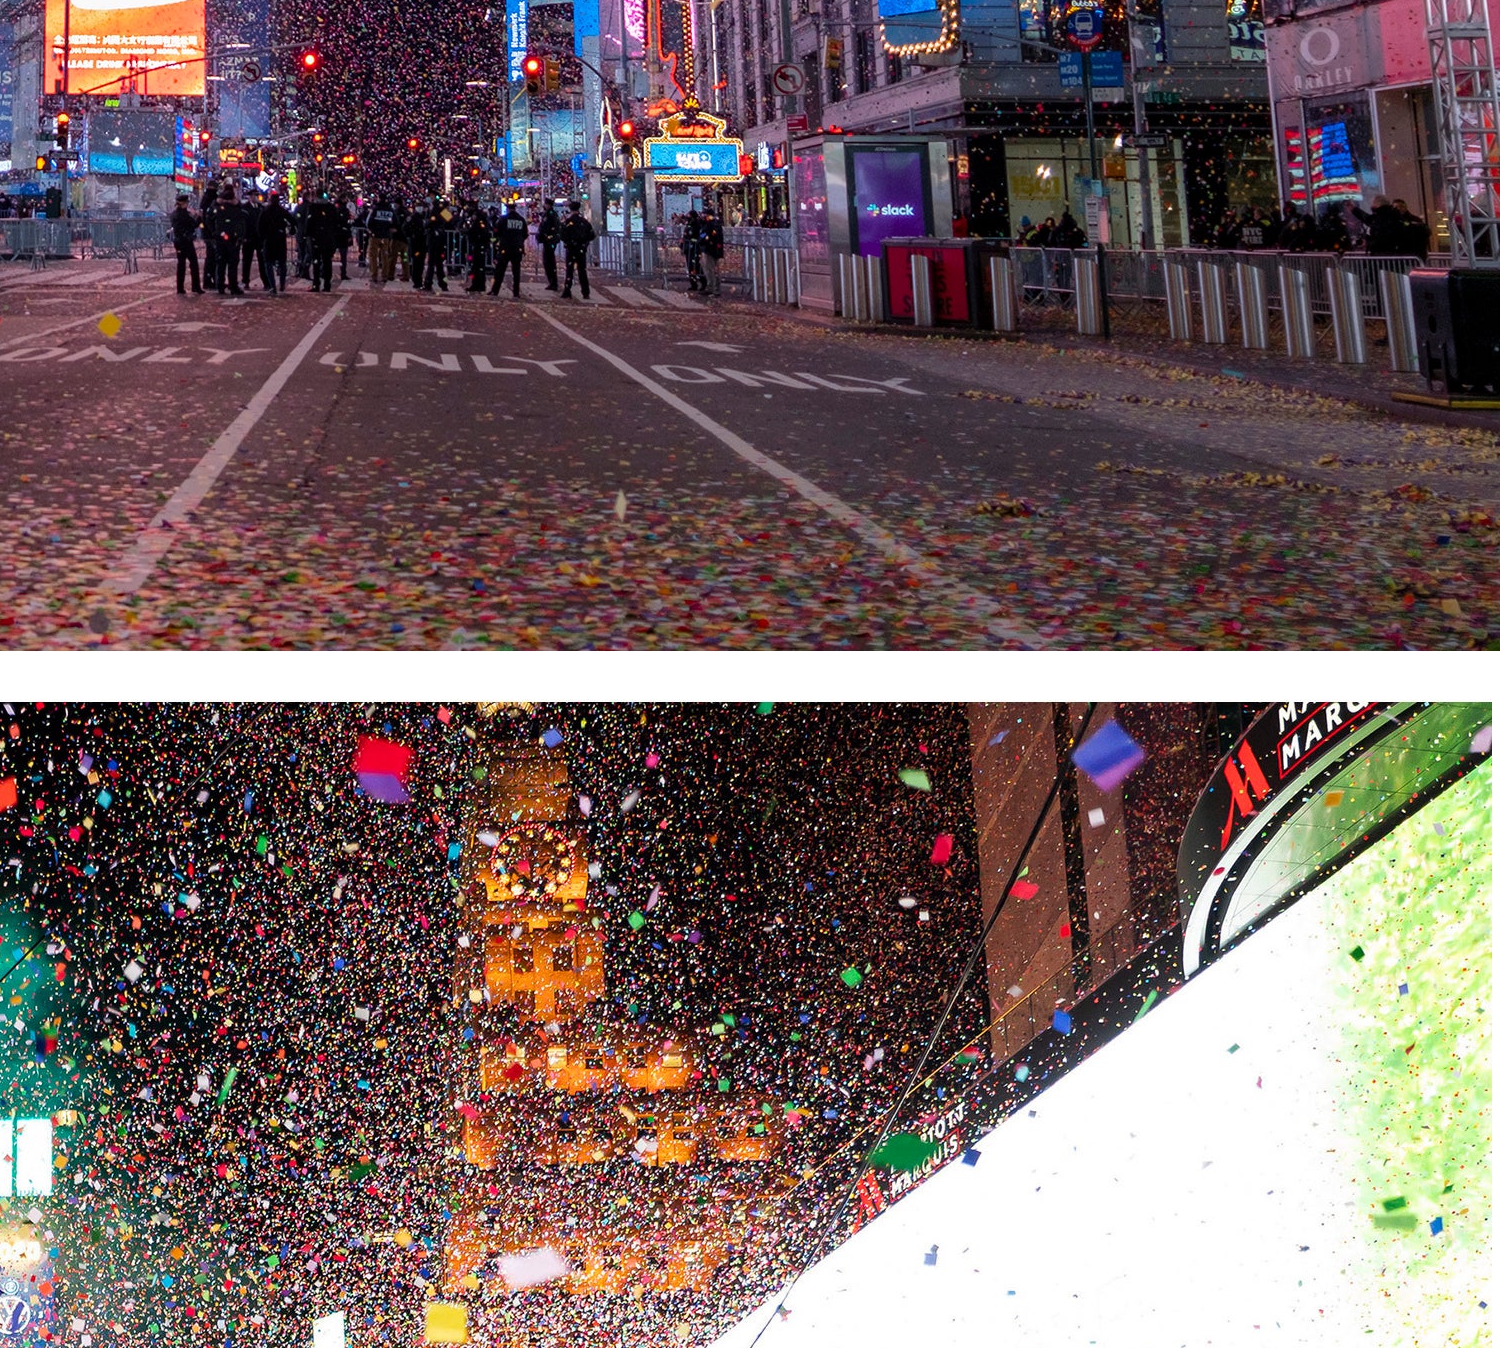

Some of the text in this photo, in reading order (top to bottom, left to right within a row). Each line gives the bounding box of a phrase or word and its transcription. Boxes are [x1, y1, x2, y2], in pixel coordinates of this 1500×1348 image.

[1060, 65, 1079, 75] M20
[1061, 76, 1083, 87] M104
[1293, 66, 1353, 92] OAKLEY
[881, 203, 915, 218] slack
[1241, 226, 1264, 236] NYC
[319, 351, 578, 377] ONLY
[650, 363, 927, 396] ONLY
